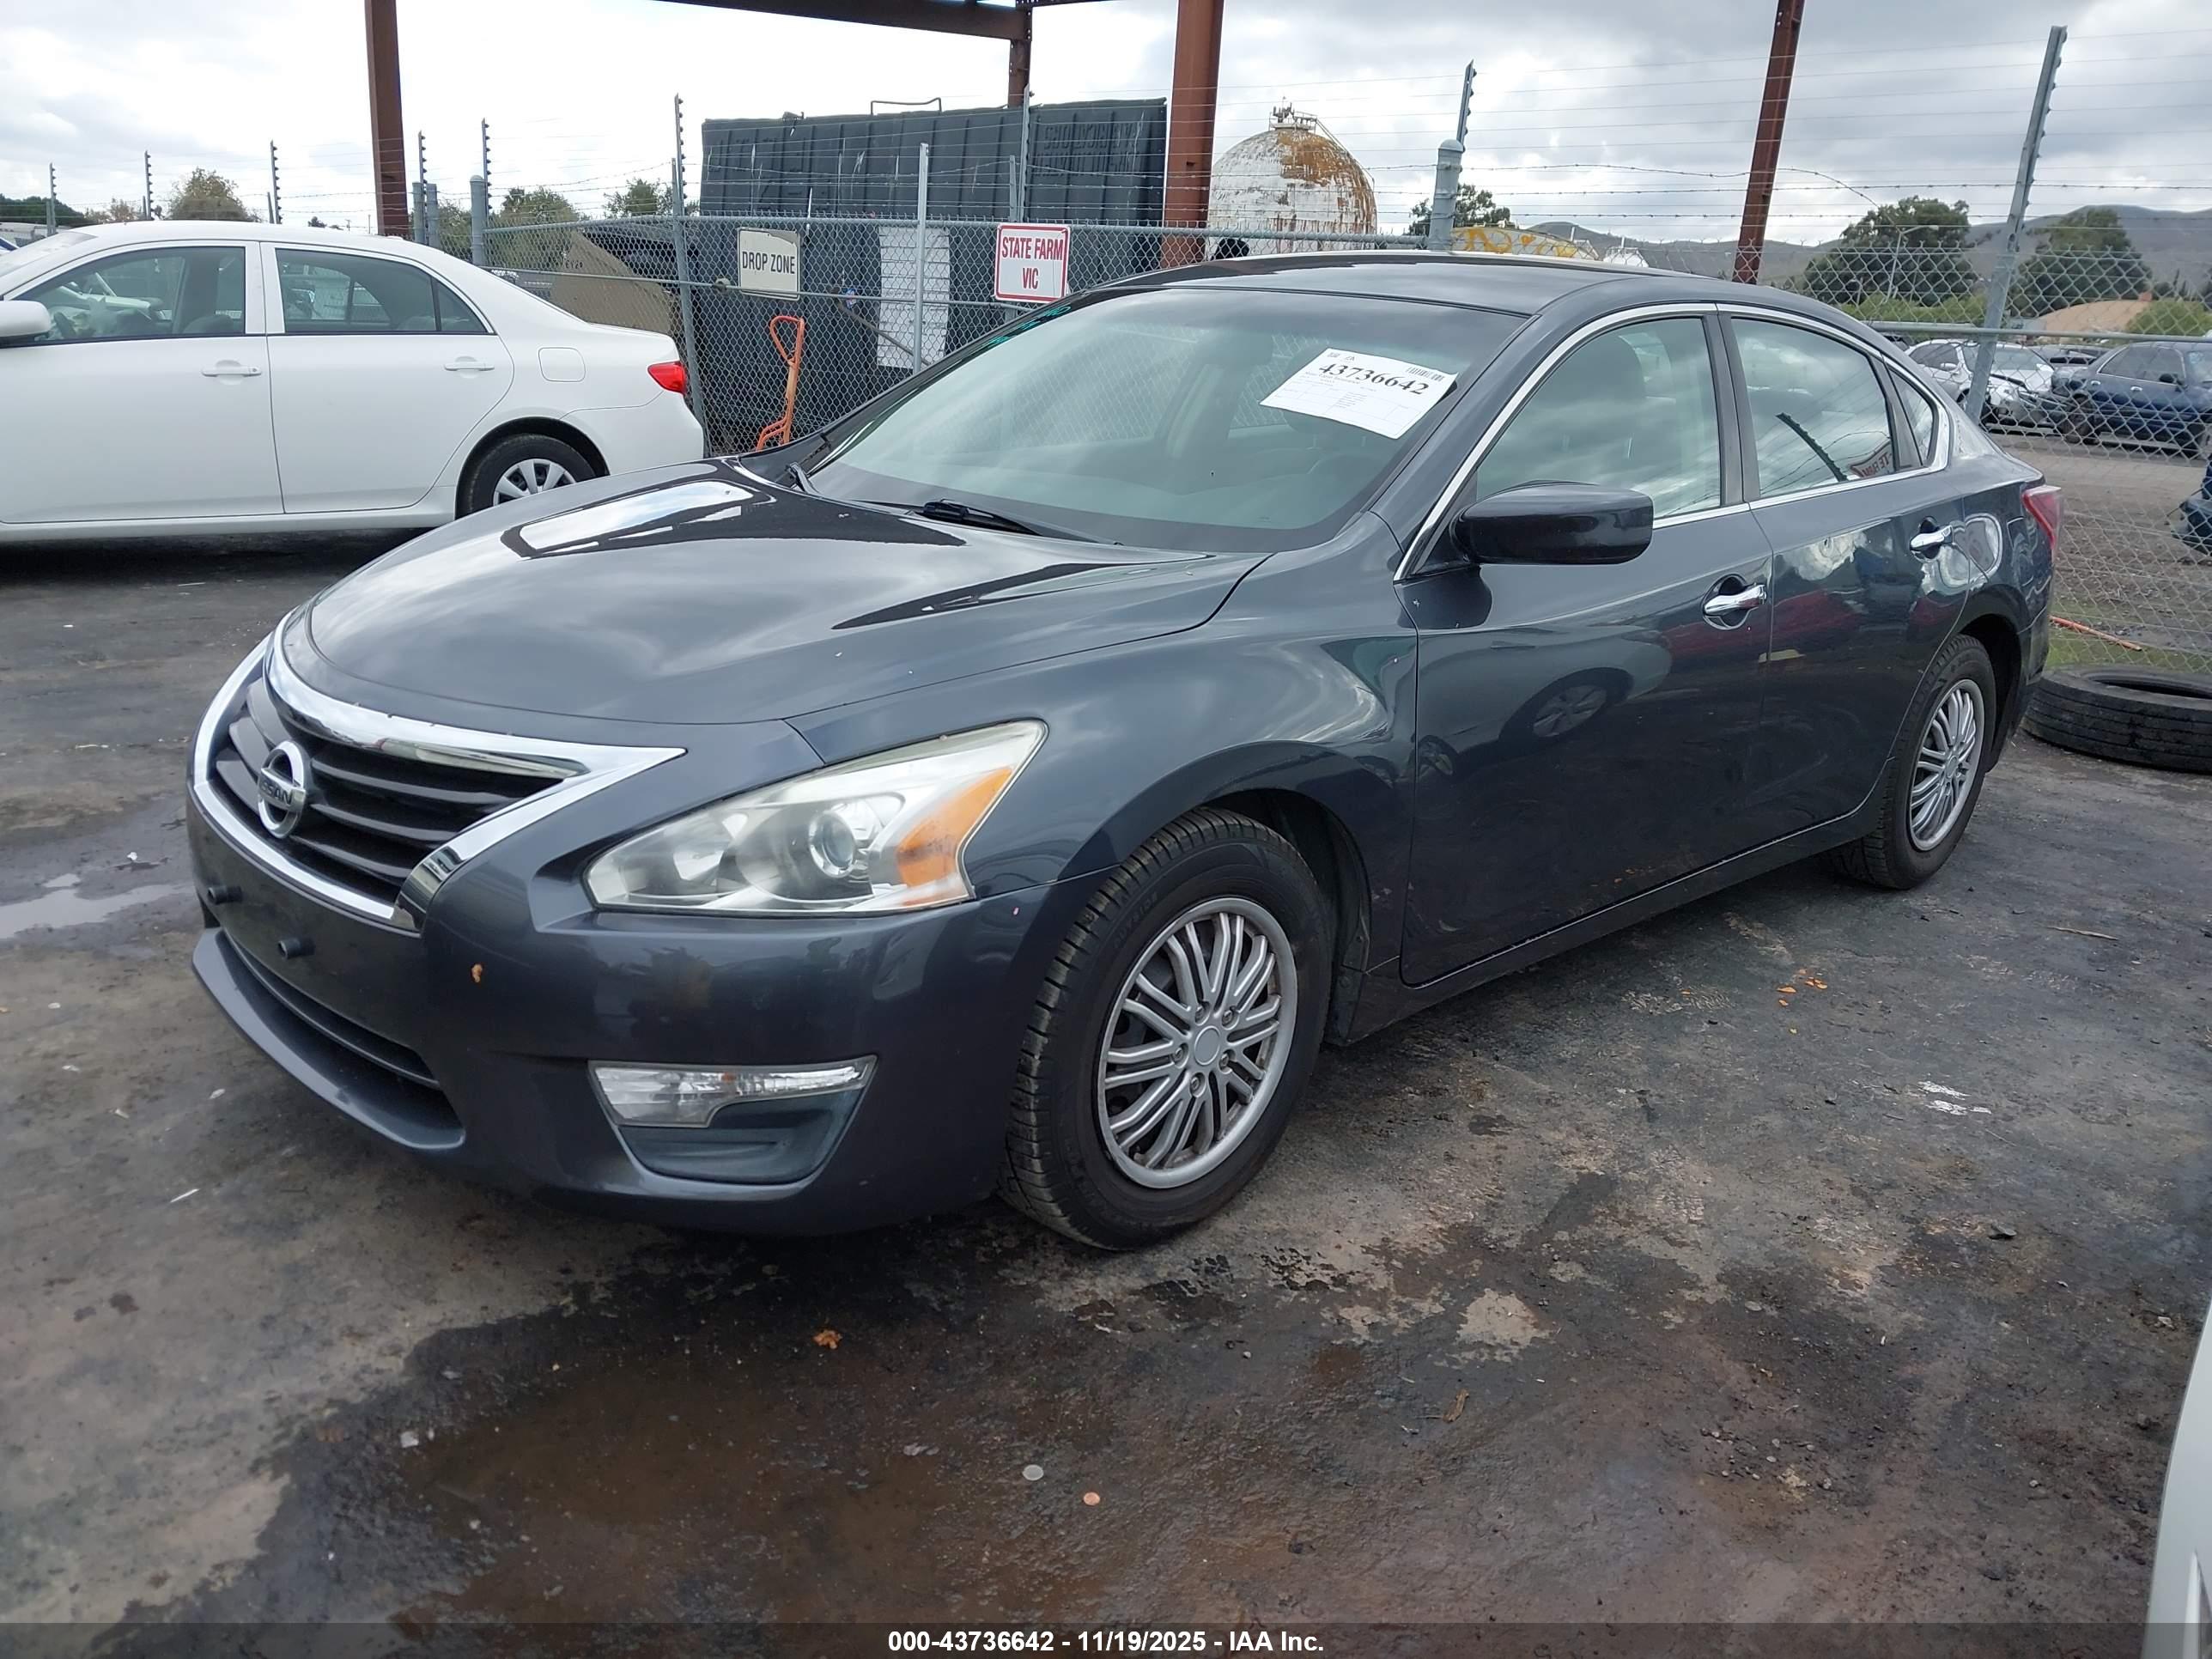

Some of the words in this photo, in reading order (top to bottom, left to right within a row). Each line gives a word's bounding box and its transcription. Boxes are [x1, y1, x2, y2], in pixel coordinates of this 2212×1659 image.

[1001, 236, 1032, 259] STATE
[1035, 238, 1064, 260] FARM
[742, 251, 769, 271] DROP
[770, 253, 795, 274] ZONE
[1022, 267, 1039, 289] VIC
[1319, 362, 1430, 395] 43736642
